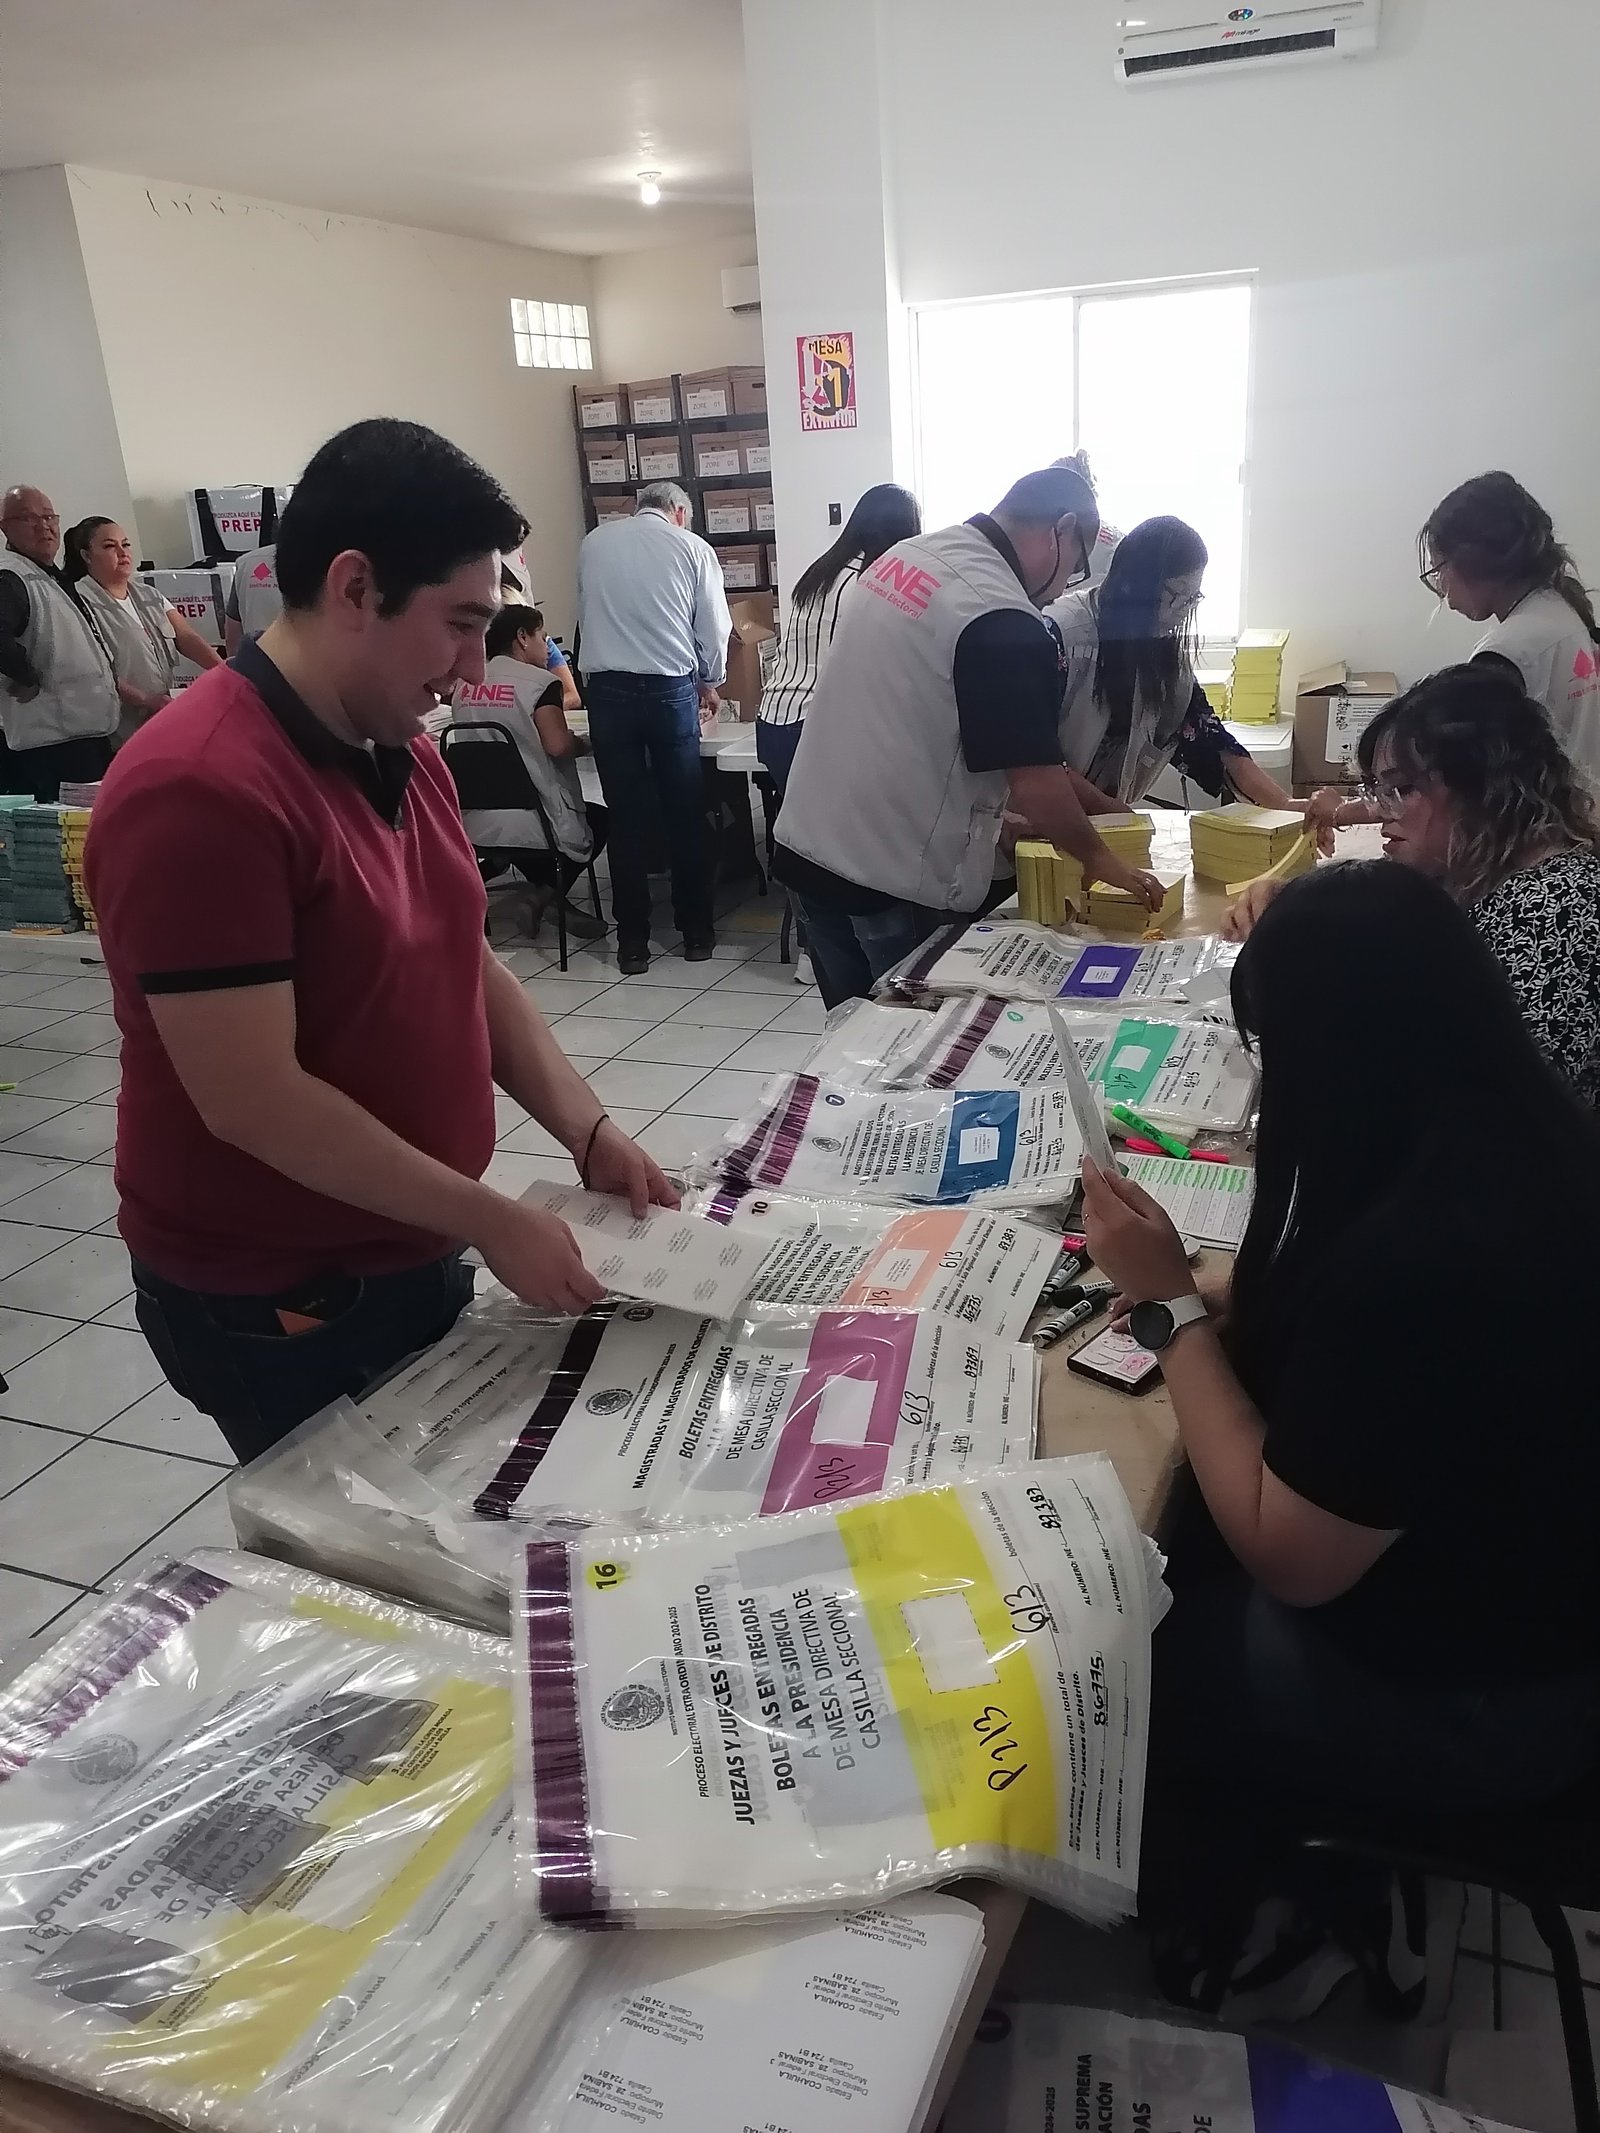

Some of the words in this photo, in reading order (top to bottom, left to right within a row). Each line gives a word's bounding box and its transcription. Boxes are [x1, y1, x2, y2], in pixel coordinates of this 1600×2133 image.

[808, 339, 843, 355] MESA
[221, 518, 262, 533] PREP
[874, 556, 942, 610] INE
[176, 604, 206, 618] REP
[886, 592, 923, 620] Electoral
[934, 1125, 947, 1152] SECCIONAL
[930, 1154, 941, 1173] CASILLA
[750, 1200, 770, 1217] 10
[998, 1228, 1015, 1250] 87387
[797, 1243, 831, 1281] ENTREGADAS
[938, 1250, 963, 1268] 613
[926, 1358, 936, 1378] boletas
[679, 1410, 708, 1458] BOLETAS
[698, 1346, 733, 1409] ENTREGADAS
[731, 1419, 753, 1444] MESA
[743, 1368, 769, 1416] DIRECTIVA
[751, 1414, 775, 1450] CASILLA
[765, 1362, 793, 1412] SECCIONAL
[900, 1390, 931, 1428] 613
[618, 1432, 634, 1456] PROCESO
[629, 1405, 647, 1431] ELECTORAL
[633, 1425, 666, 1488] MAGISTRADAS
[663, 1360, 693, 1416] MAGISTRADOS
[981, 1491, 998, 1516] elección
[1001, 1532, 1017, 1557] boletas
[595, 1564, 617, 1589] 16
[1070, 1561, 1088, 1594] NÚMERO:
[1107, 1563, 1120, 1601] NÚMERO:
[695, 1585, 719, 1641] DISTRITO
[792, 1589, 812, 1609] DE
[1004, 1583, 1049, 1633] 613
[668, 1606, 680, 1637] 2024-2025
[823, 1592, 859, 1667] SECCIONAL
[705, 1643, 723, 1667] DE
[738, 1598, 775, 1698] ENTREGADAS
[770, 1610, 809, 1711] PRESIDENCIA
[799, 1610, 832, 1680] DIRECTIVA
[673, 1638, 694, 1711] EXTRAORDINARIO
[1090, 1657, 1106, 1725] 86775
[710, 1670, 738, 1736] JUECES
[820, 1684, 847, 1739] MESA
[846, 1670, 880, 1748] CASILLA
[1059, 1686, 1071, 1711] total
[1073, 1671, 1084, 1717] Distrito.
[686, 1712, 702, 1754] ELECTORAL
[796, 1714, 815, 1738] LA
[724, 1738, 741, 1751] Y
[762, 1702, 795, 1790] BOLETAS
[802, 1746, 821, 1758] A
[832, 1743, 855, 1770] DE
[694, 1756, 709, 1797] PROCESO
[727, 1756, 754, 1824] JUEZAS
[813, 1976, 848, 1990] SABINAS
[814, 1994, 855, 2010] COAHUILA
[778, 2052, 814, 2067] SABINAS
[779, 2071, 821, 2089] COAHUILA
[1074, 2053, 1092, 2131] SUPREMA
[576, 2092, 617, 2112] COAHUILA
[1096, 2081, 1114, 2133] ACIÓN
